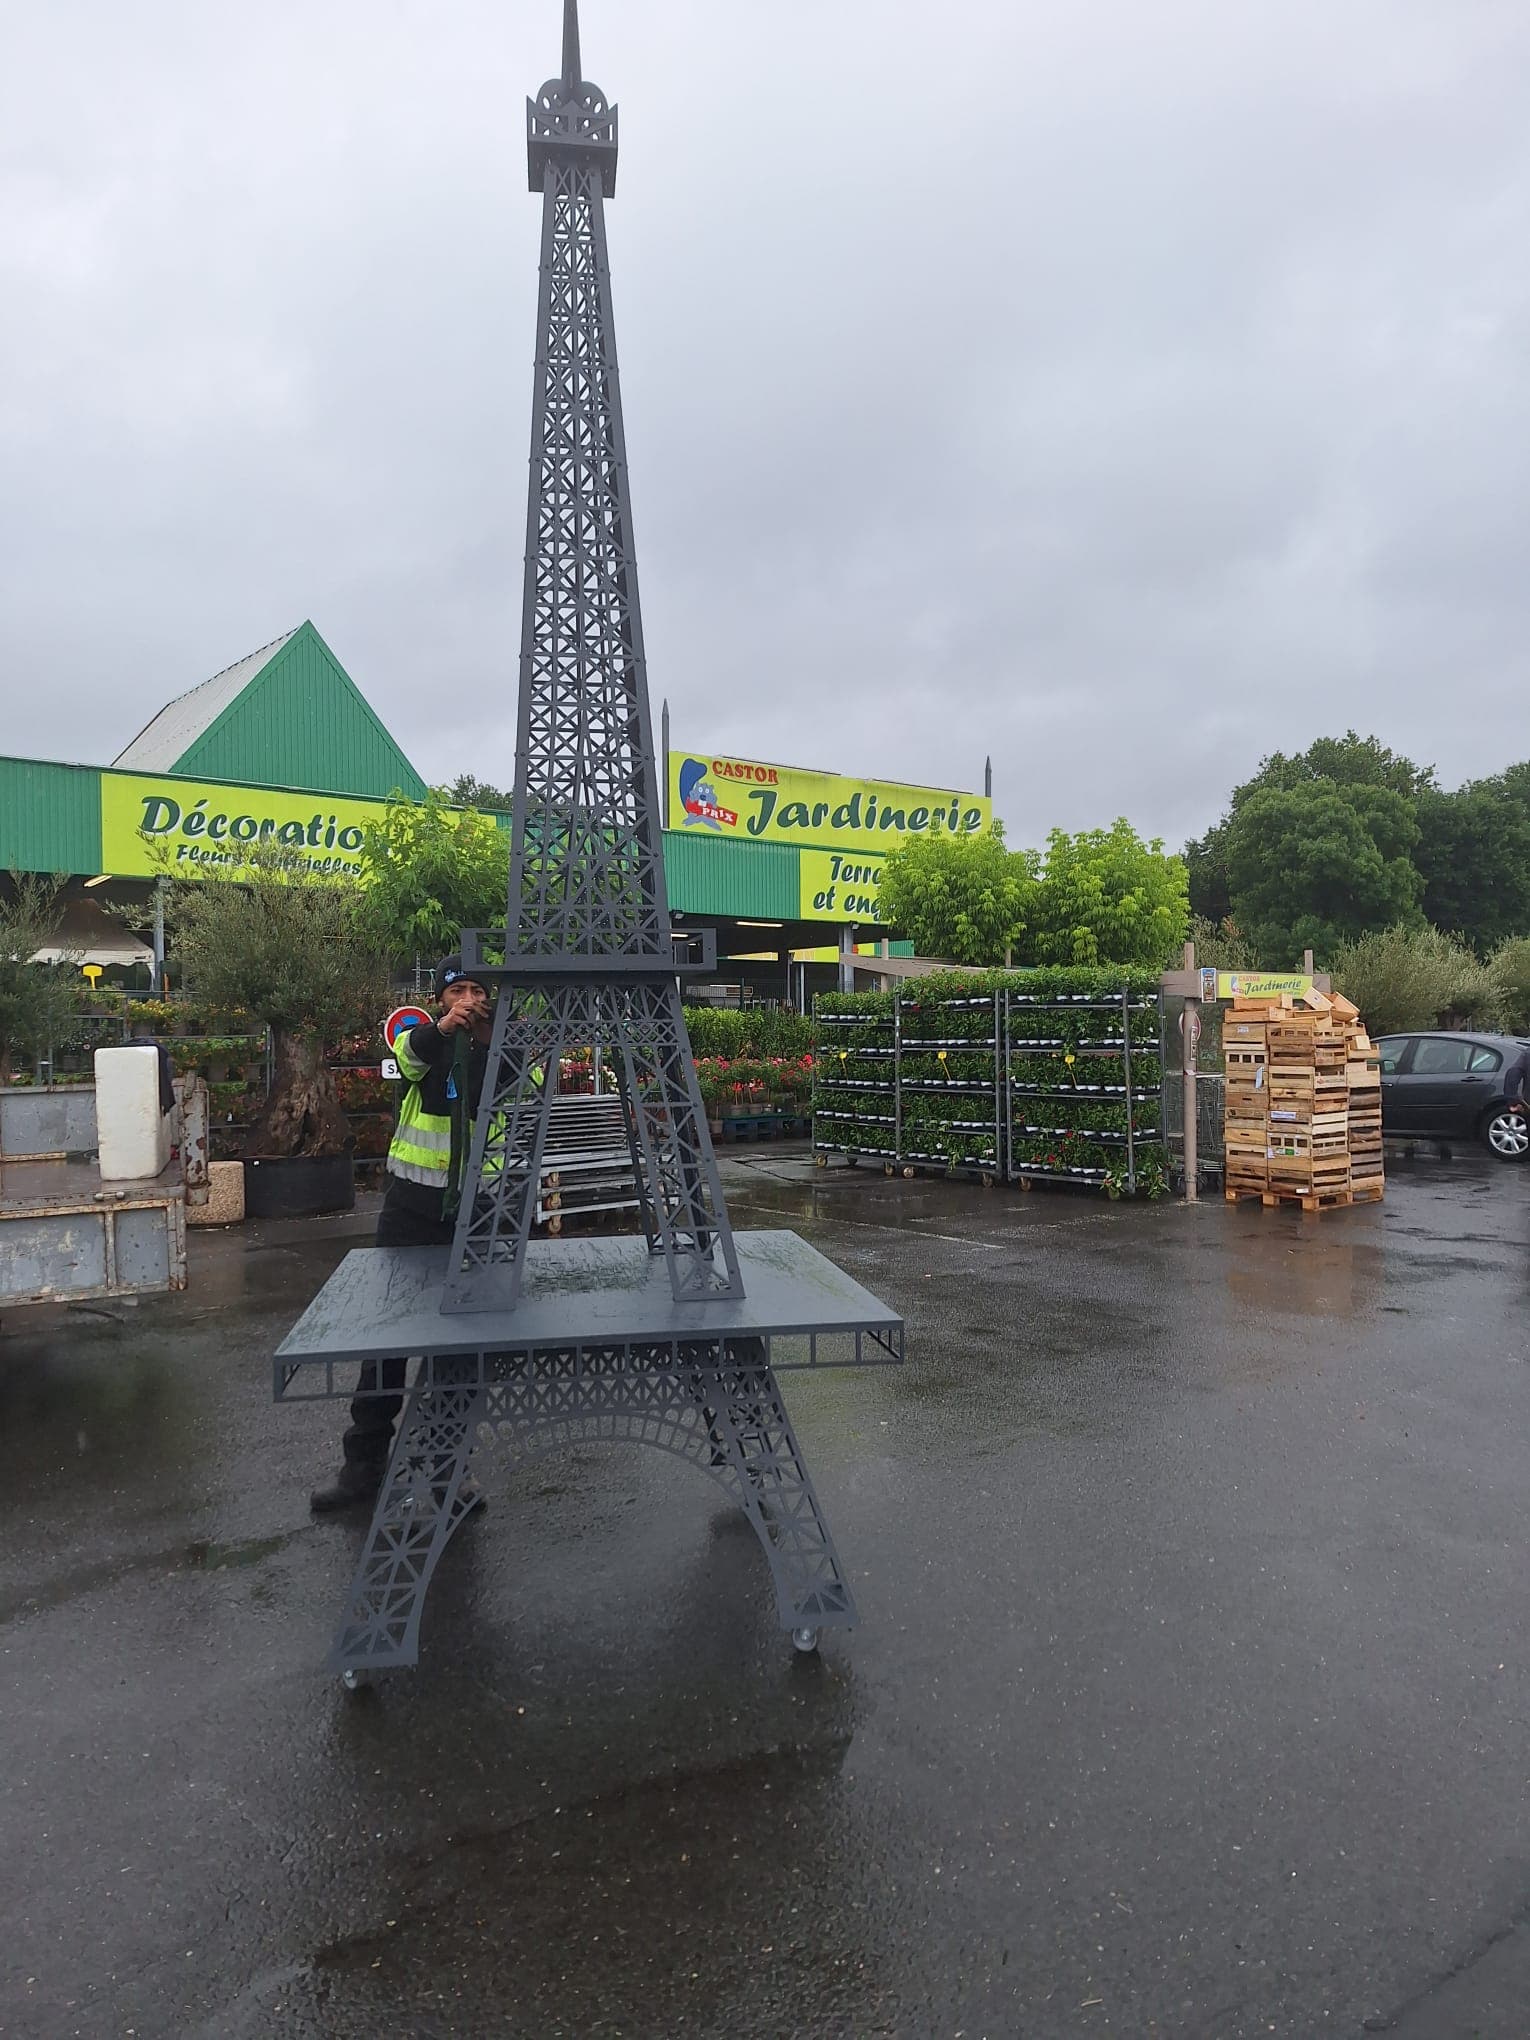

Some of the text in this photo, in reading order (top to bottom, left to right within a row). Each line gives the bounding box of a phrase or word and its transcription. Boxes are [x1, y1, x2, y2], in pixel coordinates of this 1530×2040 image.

[713, 760, 779, 784] CASTOR
[141, 796, 368, 851] Décoratio
[702, 807, 735, 823] PRIX
[747, 790, 981, 837] Jardinerie
[813, 886, 835, 911] et
[1245, 979, 1302, 996] Jardinerie
